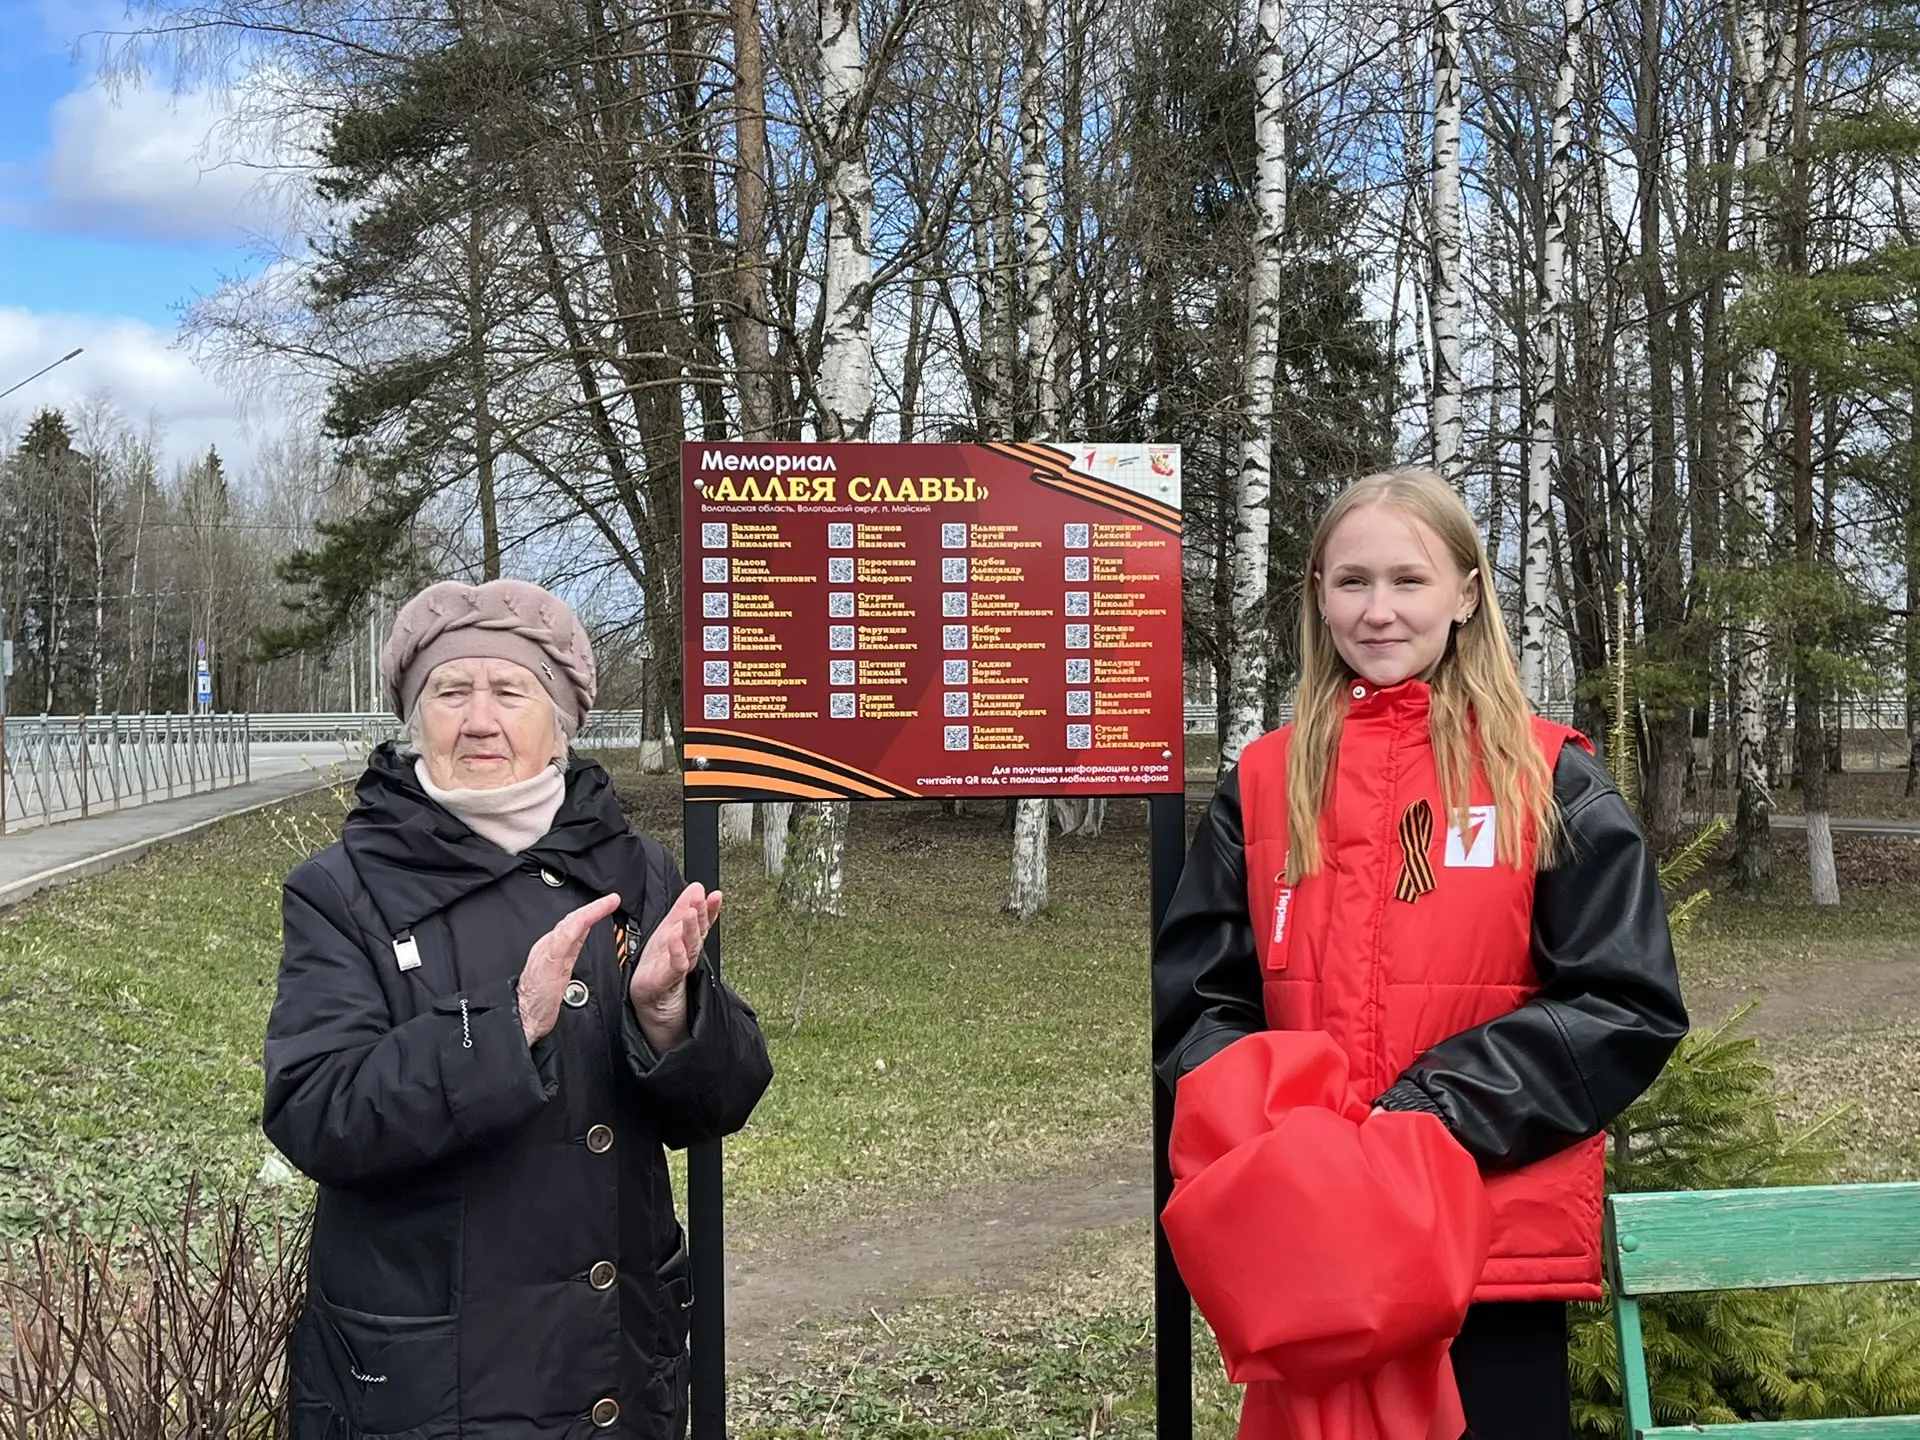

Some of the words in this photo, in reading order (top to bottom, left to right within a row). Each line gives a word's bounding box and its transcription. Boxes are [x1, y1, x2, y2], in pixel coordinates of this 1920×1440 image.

[701, 451, 836, 474] Мемориал
[702, 477, 836, 501] «АЛЛЕЯ
[848, 478, 989, 501] СЛАВЫ»
[701, 505, 756, 513] Вологодская
[798, 505, 852, 513] Вологодский
[971, 532, 1004, 540] Сергей
[971, 541, 1042, 549] Владимирович
[1093, 540, 1165, 549] Александрович
[732, 558, 766, 566] Власов
[971, 558, 1005, 566] Клубов
[971, 566, 1021, 574] Александр
[858, 575, 912, 584] Фёдорович
[971, 575, 1024, 583] Фёдорович
[1093, 573, 1159, 582] Никифорович
[733, 601, 774, 609] Василий
[972, 601, 1019, 609] Владимир
[1094, 608, 1166, 617] Александрович
[972, 625, 1011, 634] Каберов
[733, 634, 775, 642] Николай
[859, 635, 888, 643] Борис
[972, 634, 1000, 642] Игорь
[1094, 632, 1127, 641] Сергей
[972, 643, 1045, 651] Александрович
[972, 669, 1001, 677] Борис
[734, 678, 807, 687] Владимирович
[972, 693, 1024, 701] Мушников
[1095, 690, 1152, 698] Павловский
[734, 695, 787, 703] Панкратов
[734, 703, 786, 711] Александр
[859, 702, 895, 710] Генрих
[973, 701, 1021, 709] Владимир
[860, 710, 918, 719] Генрихович
[973, 709, 1046, 717] Александрович
[1095, 725, 1128, 733] Суслов
[1095, 733, 1128, 741] Сергей
[1095, 741, 1168, 749] Александрович
[992, 766, 1010, 775] Для
[1065, 766, 1129, 774] информации
[1140, 765, 1168, 774] герое
[917, 776, 963, 785] считайте
[965, 776, 979, 785] QR
[981, 777, 999, 785] код
[1010, 776, 1058, 784] помощью
[1060, 774, 1117, 783] мобильного
[1119, 774, 1168, 782] телефона
[1274, 889, 1291, 943] Первые
